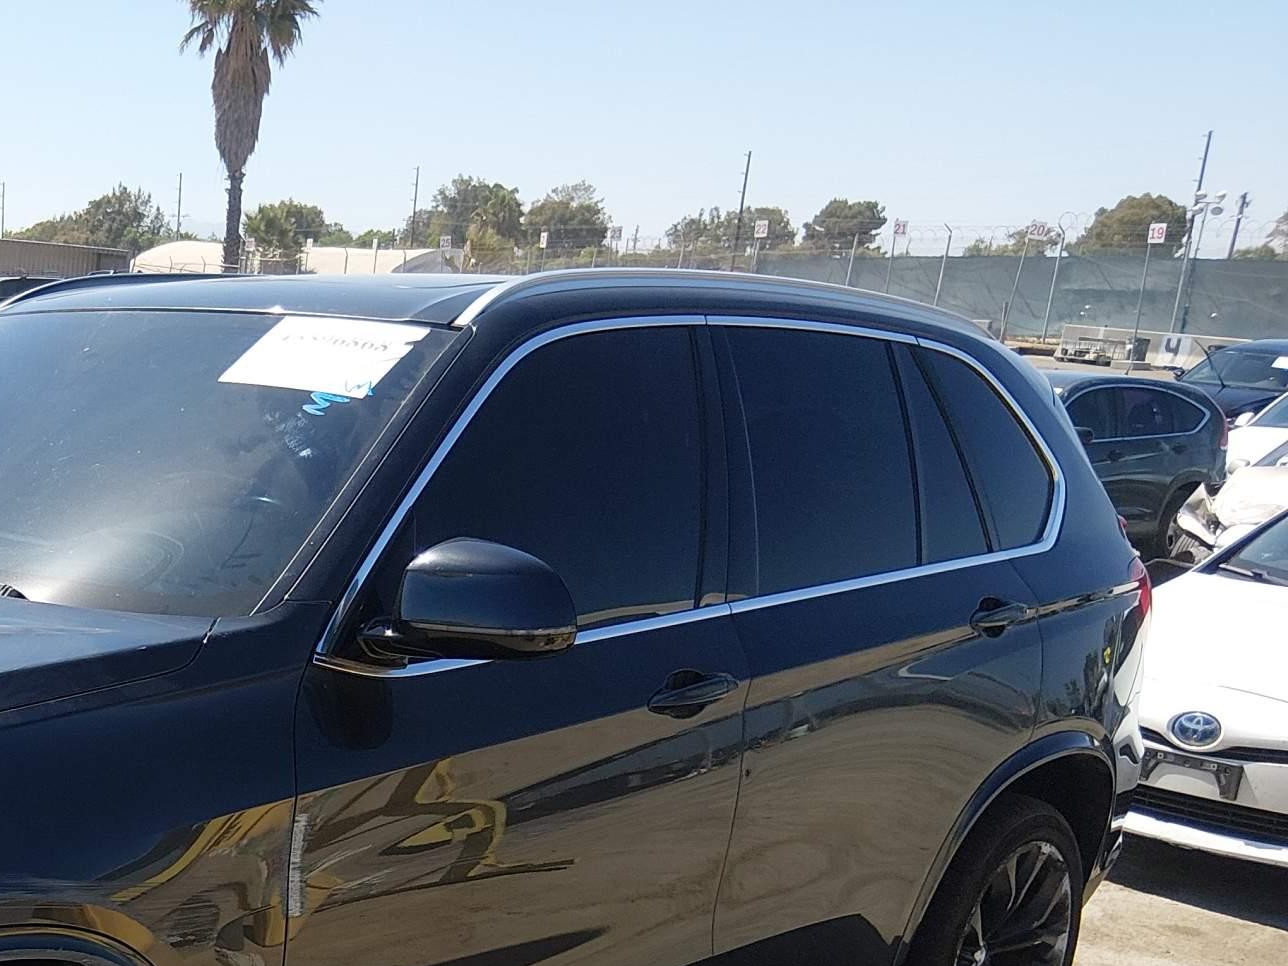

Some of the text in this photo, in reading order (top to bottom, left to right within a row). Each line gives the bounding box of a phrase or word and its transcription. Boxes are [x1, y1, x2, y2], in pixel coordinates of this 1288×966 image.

[894, 223, 906, 234] 21
[1031, 223, 1045, 236] 20
[1149, 227, 1164, 240] 19
